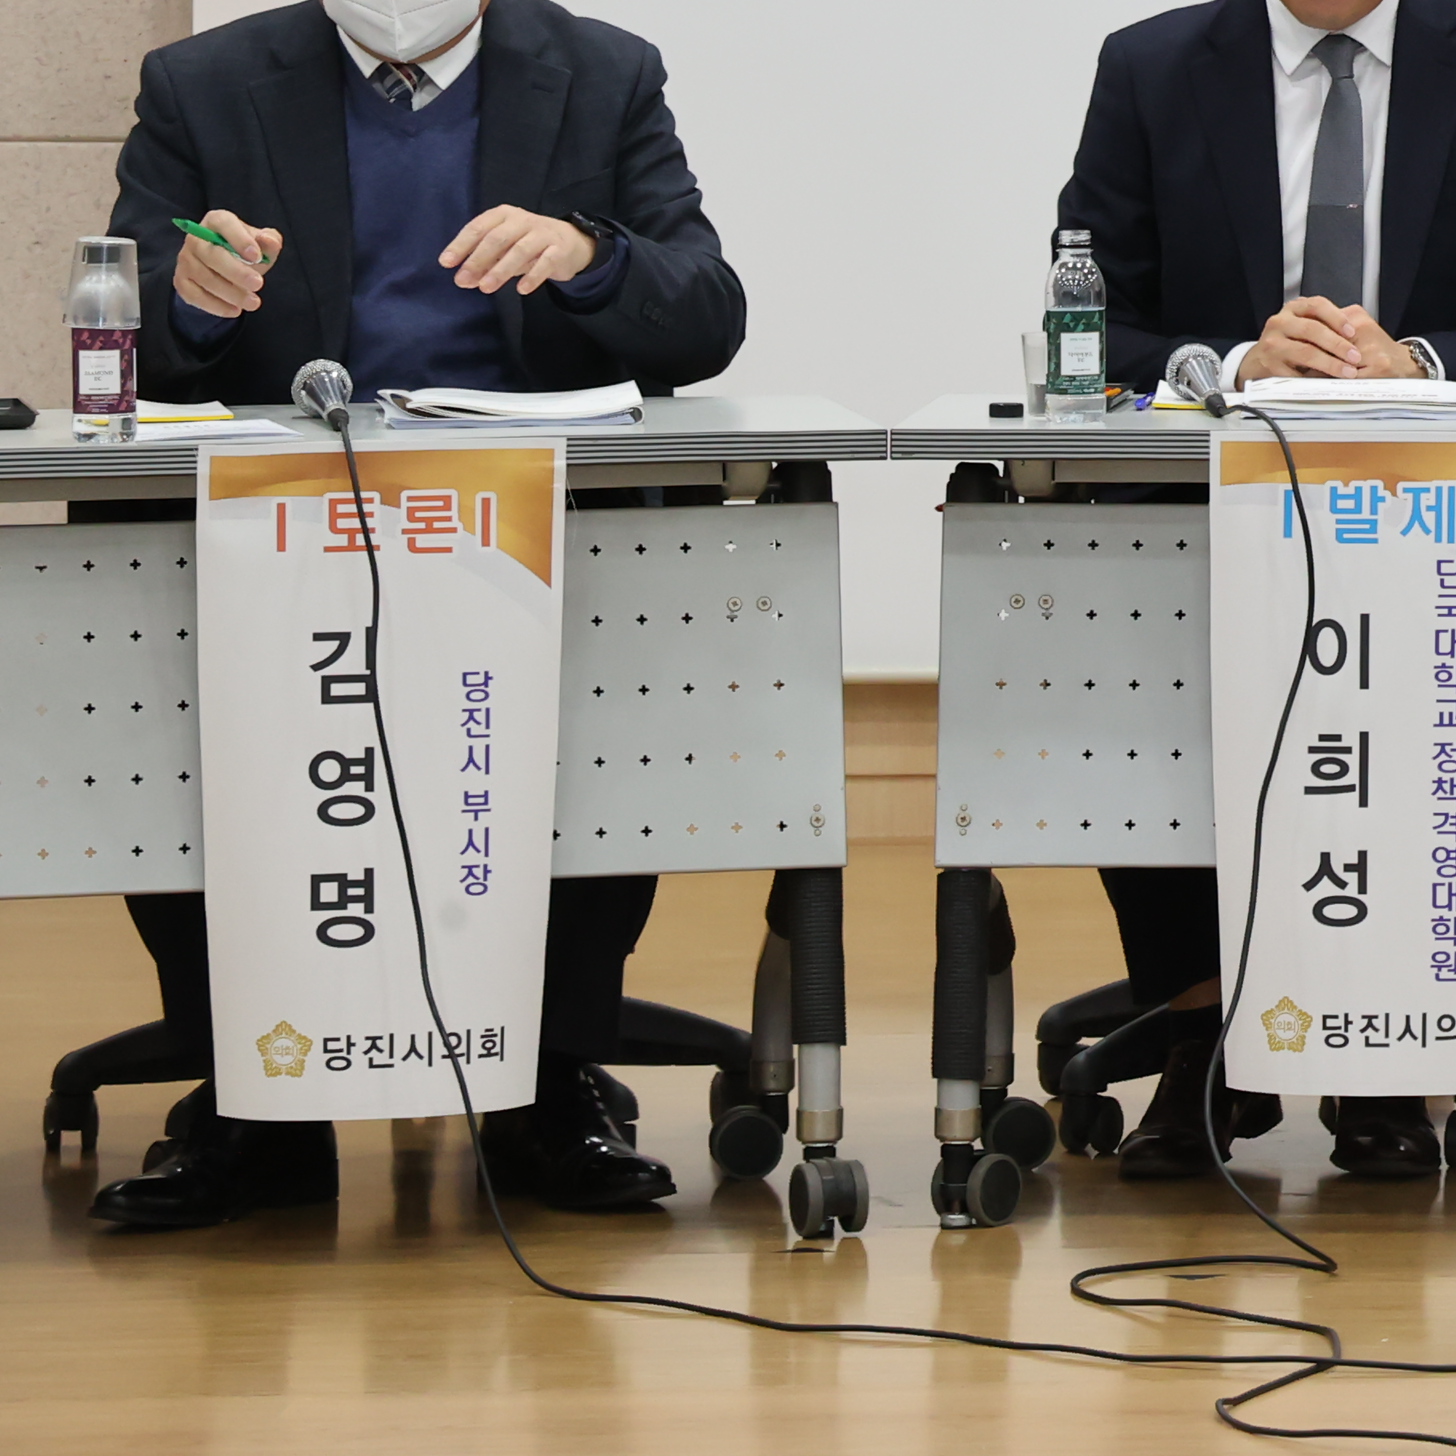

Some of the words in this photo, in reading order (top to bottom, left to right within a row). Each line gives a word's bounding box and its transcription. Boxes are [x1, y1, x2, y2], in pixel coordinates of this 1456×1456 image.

[323, 495, 459, 554] 토론
[1328, 485, 1456, 545] 발제
[460, 670, 495, 777] 당진시
[459, 789, 494, 898] 부시장
[321, 1025, 506, 1072] 당진시의회
